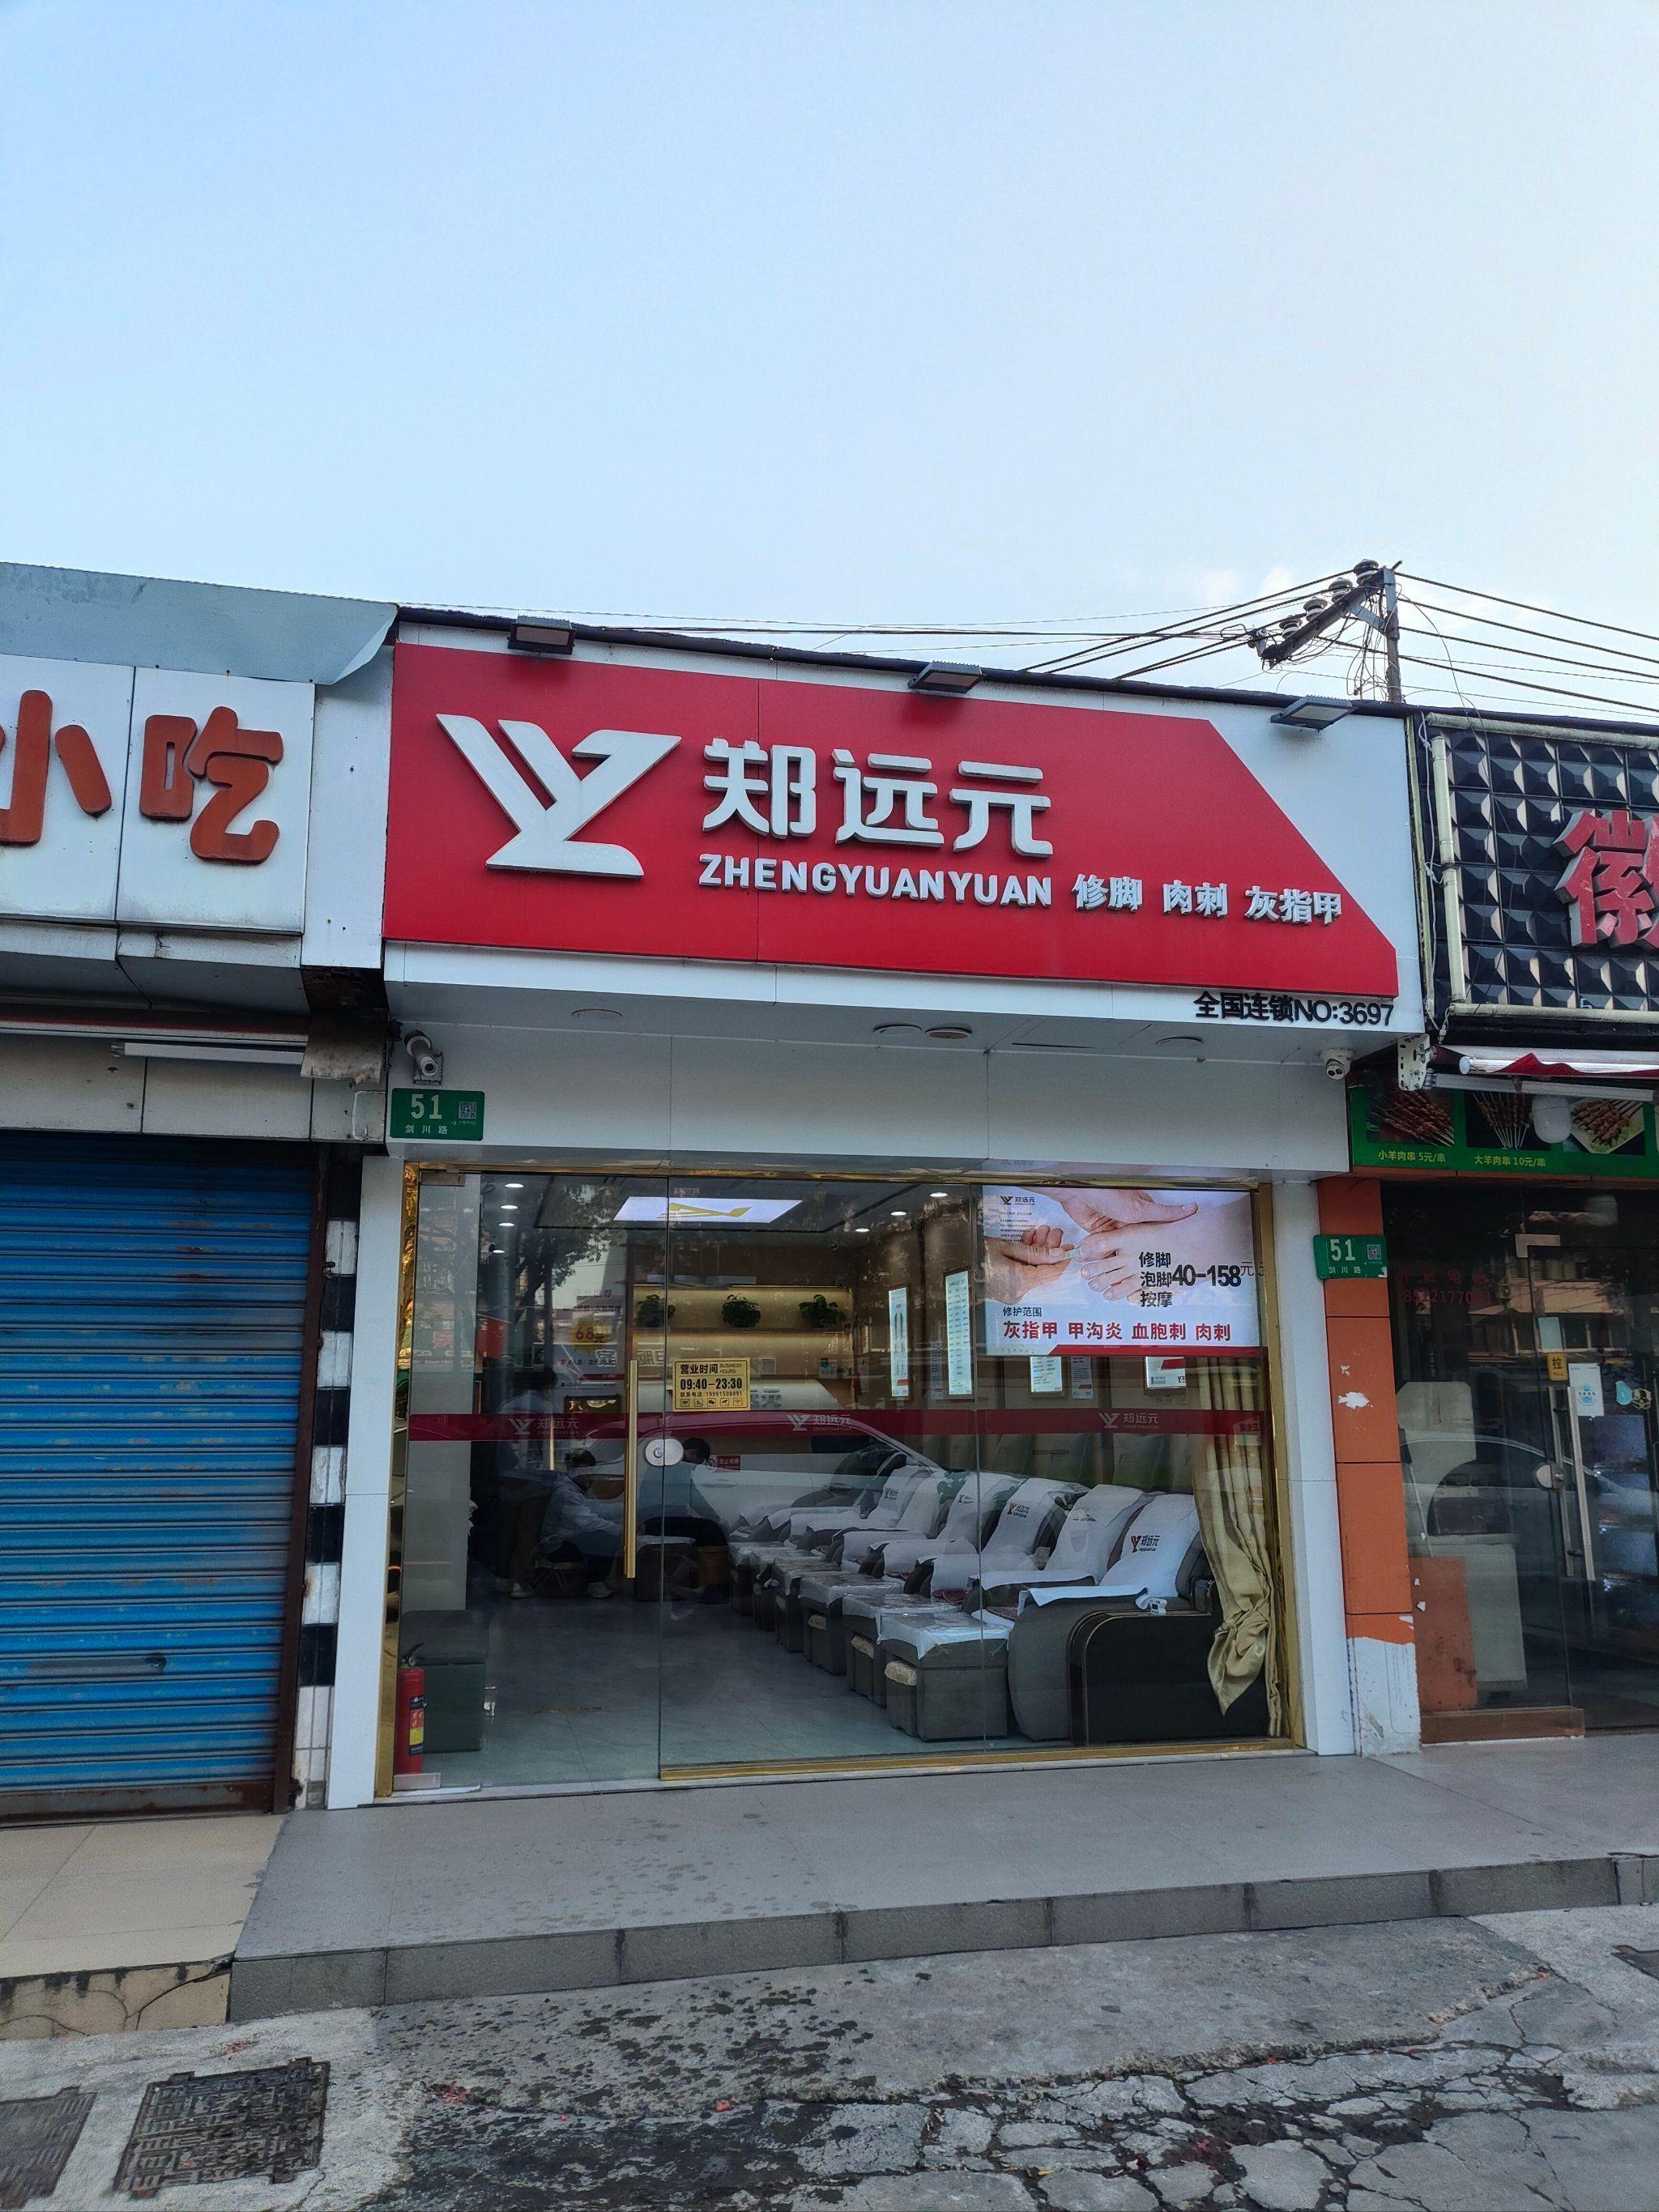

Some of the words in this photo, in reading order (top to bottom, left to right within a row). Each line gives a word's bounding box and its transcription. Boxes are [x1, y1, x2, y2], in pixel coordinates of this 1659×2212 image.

[0, 688, 284, 865] 小吃
[702, 737, 1054, 859] 郑远元
[698, 853, 1052, 908] ZHENGYUANYUAN
[1072, 874, 1143, 912] 修脚
[1162, 880, 1229, 918] 肉刺
[1244, 886, 1341, 926] 灰指甲
[411, 1093, 442, 1119] 51
[405, 1124, 448, 1135] 剑川路
[1378, 1150, 1416, 1161] 小羊肉串
[1418, 1152, 1446, 1163] 5元/串
[1474, 1155, 1511, 1166] 大羊肉串
[1513, 1157, 1546, 1168] 10元/串
[1330, 1238, 1355, 1261] 51
[1139, 1251, 1171, 1268] 修脚
[1328, 1266, 1361, 1274] 剑川路
[1141, 1272, 1172, 1288] 泡脚
[1141, 1290, 1173, 1307] 按摩
[1003, 1306, 1042, 1317] 修护范围
[1003, 1321, 1058, 1340] 灰指甲
[1068, 1322, 1123, 1340] 甲沟炎
[1132, 1323, 1186, 1340] 血胞刺
[1196, 1323, 1231, 1341] 肉刺
[680, 1363, 718, 1375] 营业时间
[1552, 1357, 1563, 1369] 拉
[812, 1414, 851, 1426] 郑远元
[1123, 1413, 1159, 1424] 郑远元
